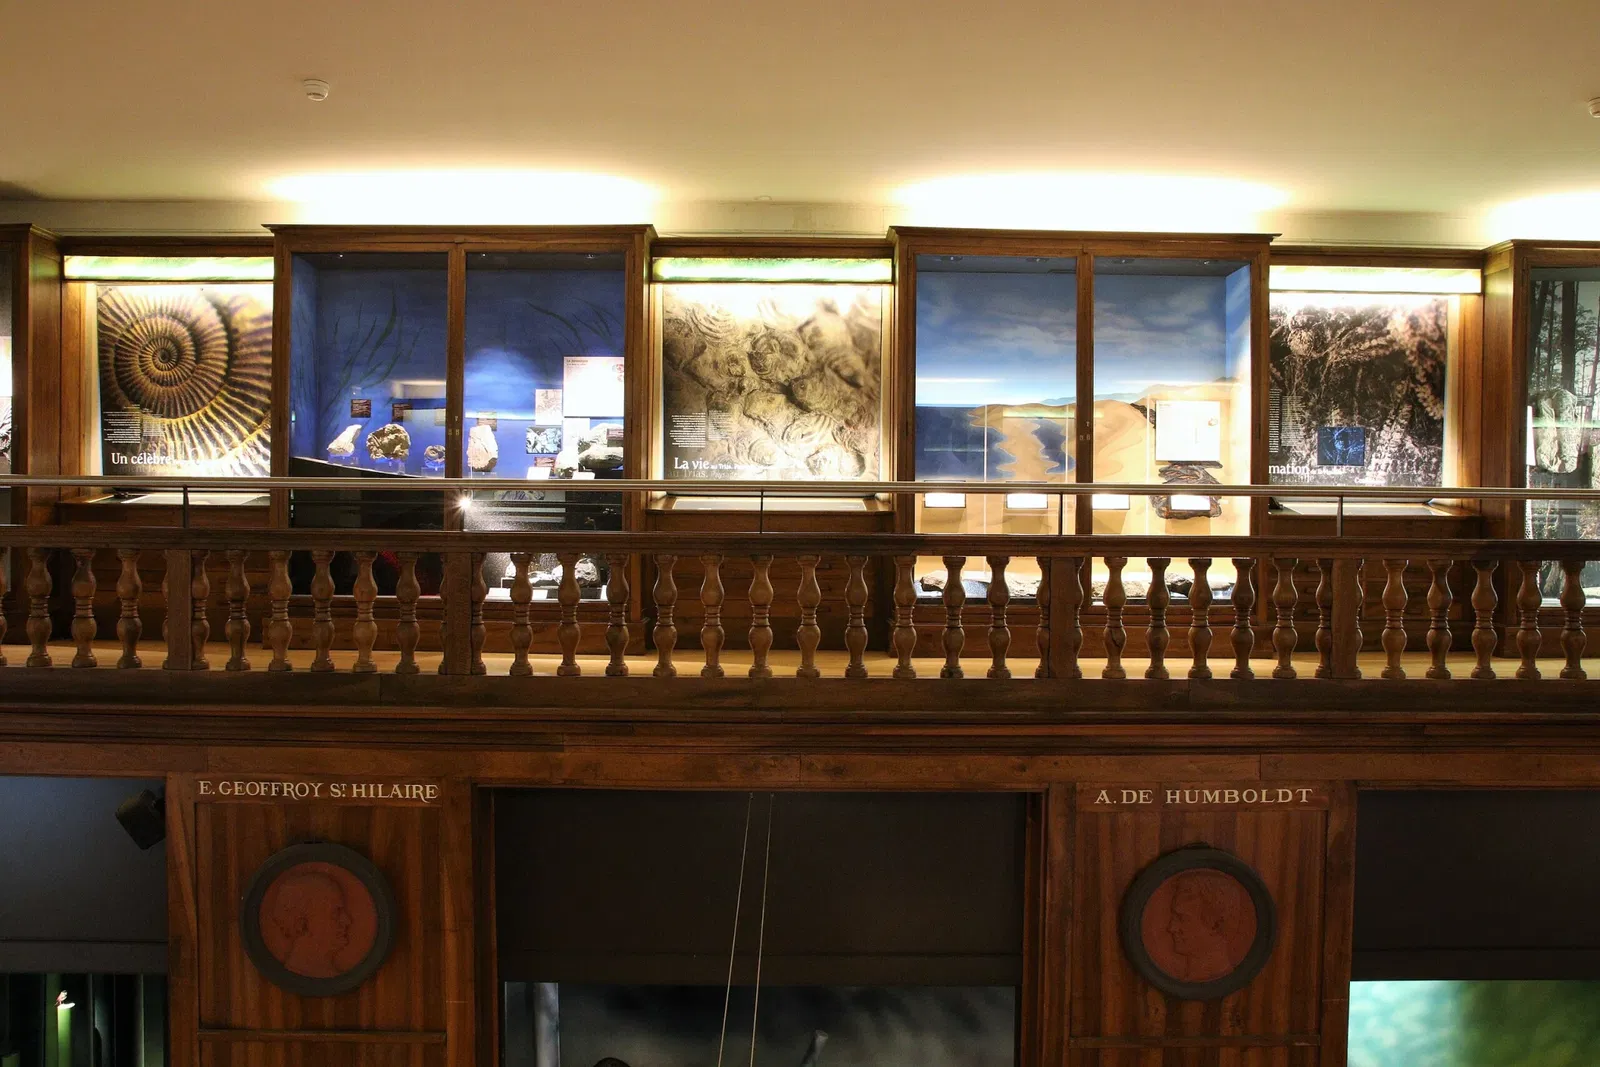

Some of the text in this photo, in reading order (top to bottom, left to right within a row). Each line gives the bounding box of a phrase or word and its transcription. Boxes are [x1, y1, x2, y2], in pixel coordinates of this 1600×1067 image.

[111, 452, 171, 465] Un célèbre
[674, 457, 689, 470] La
[692, 457, 710, 470] vie
[199, 780, 216, 796] E.
[218, 781, 324, 801] GEOFFROY
[351, 783, 439, 804] HILAIRE
[1093, 788, 1313, 805] A. DE HUMBOLDT
